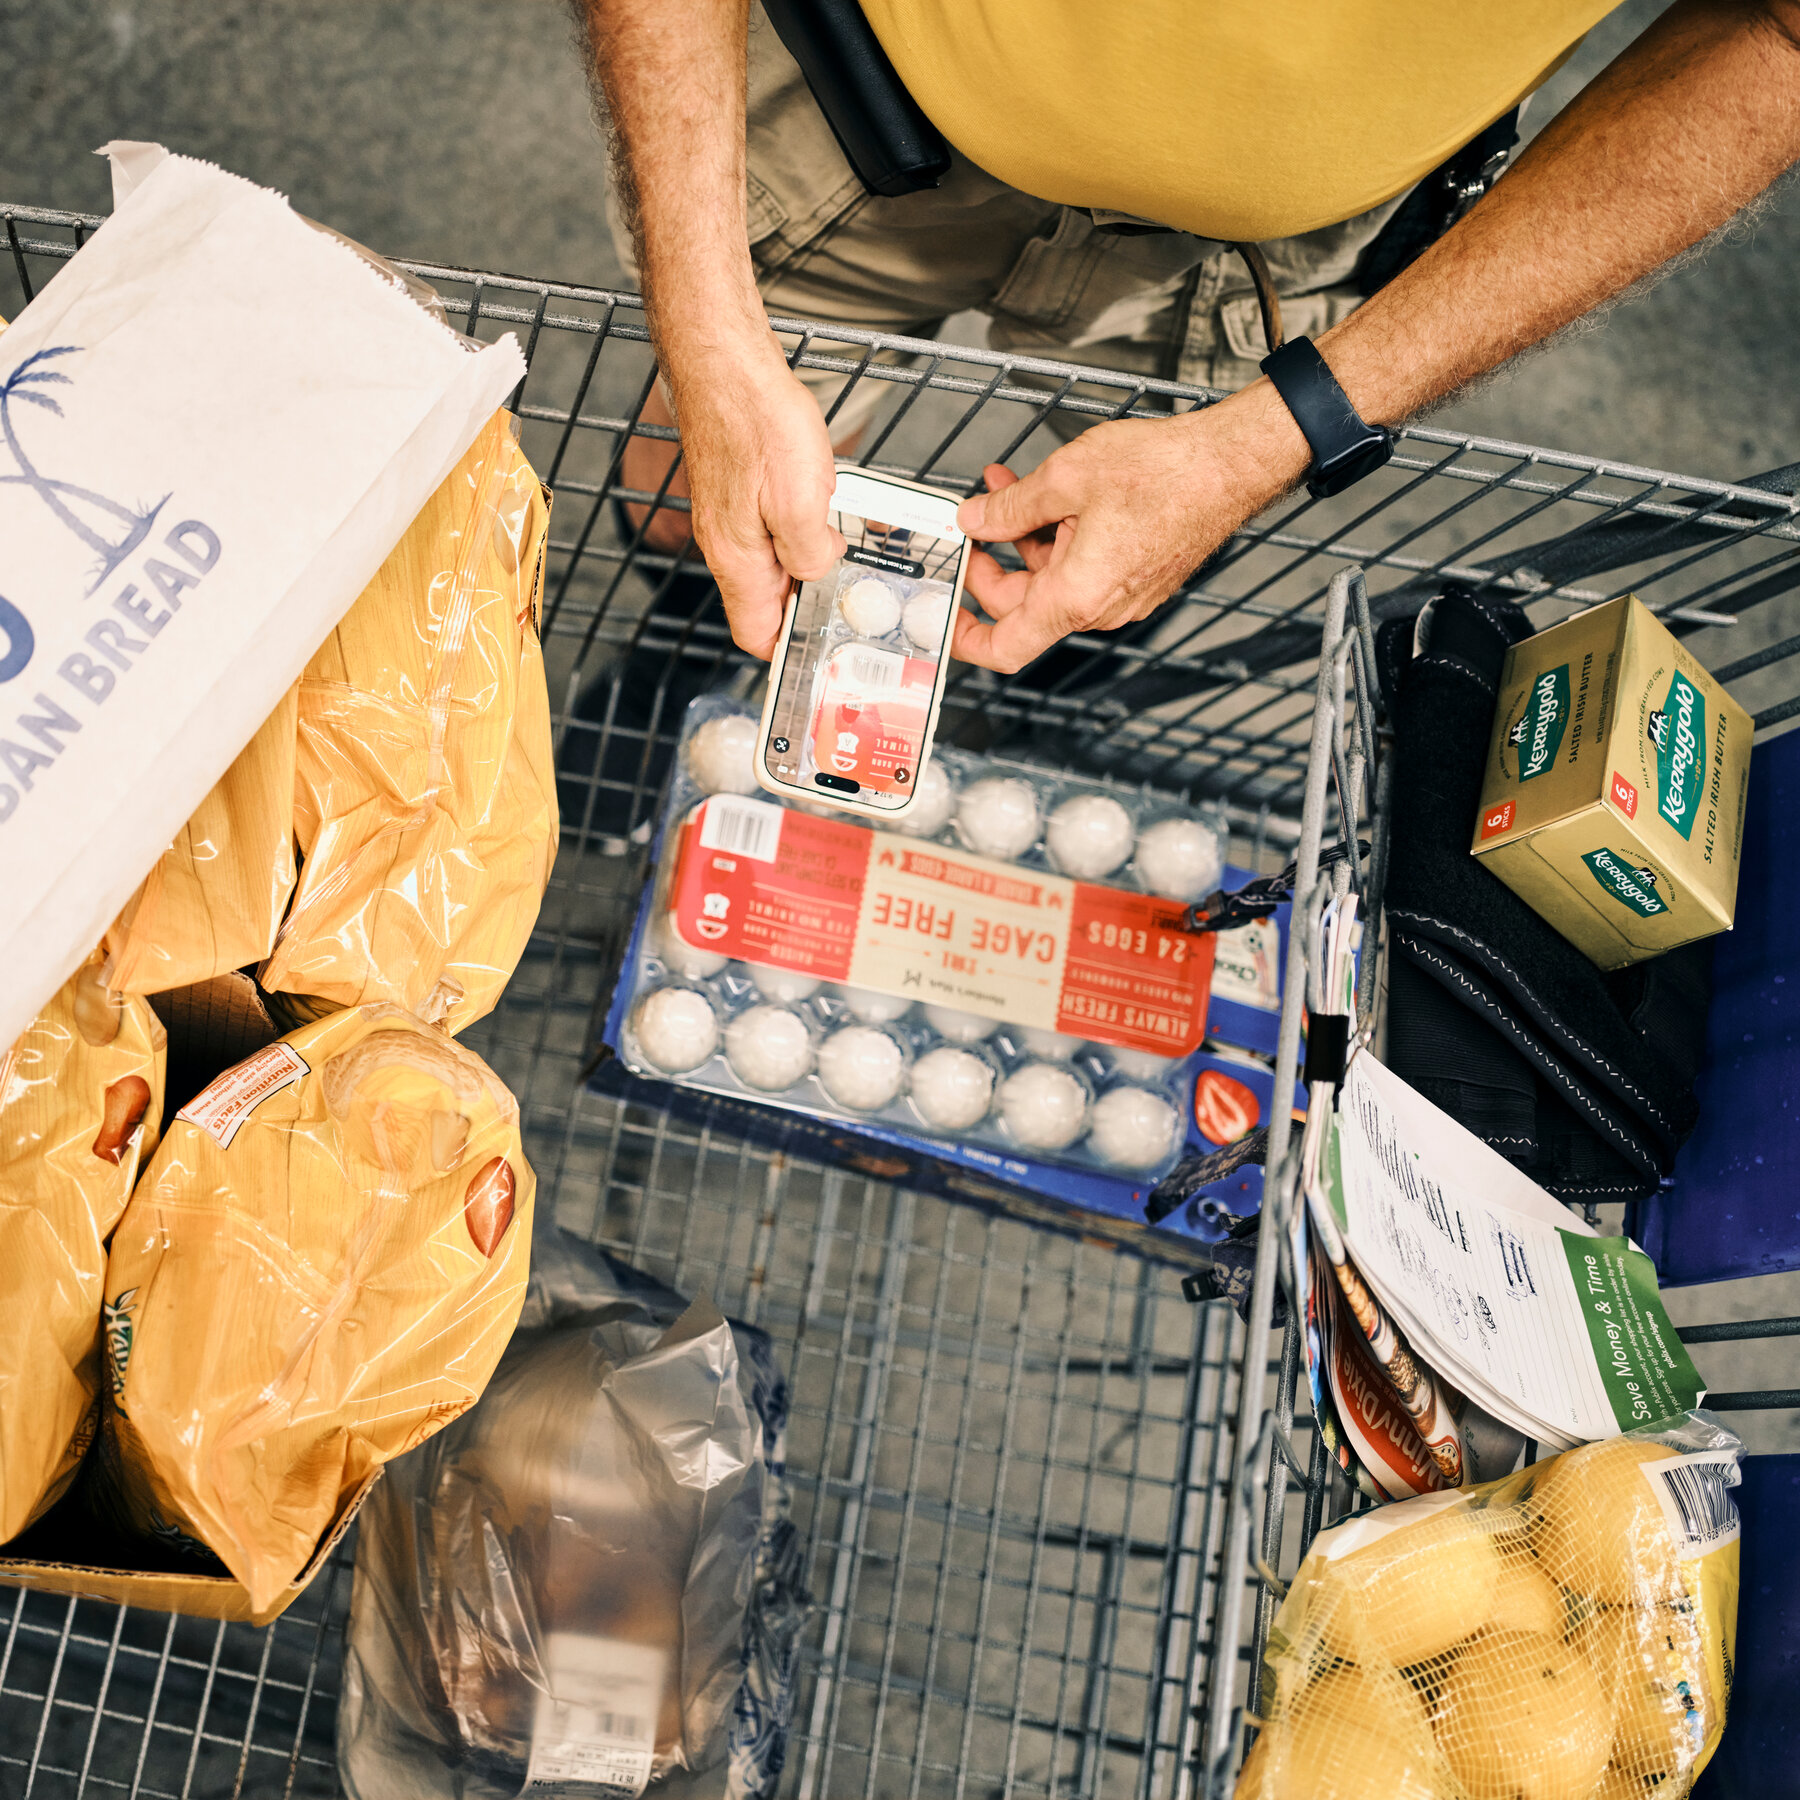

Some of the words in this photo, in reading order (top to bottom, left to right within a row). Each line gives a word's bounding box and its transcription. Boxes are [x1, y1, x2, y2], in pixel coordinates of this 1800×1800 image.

[887, 560, 899, 568] scan
[56, 519, 222, 706] BREAD
[1580, 652, 1594, 694] BUTTER
[1639, 679, 1654, 715] GRASS-FED
[1575, 695, 1587, 724] IRISH
[876, 738, 917, 754] ANIMAL
[1569, 725, 1582, 764] SALTED
[1714, 713, 1727, 767] BUTTER
[871, 758, 892, 769] BARN
[1643, 769, 1651, 789] MILK
[1709, 769, 1721, 808] IRISH
[1616, 783, 1628, 801] 6
[1626, 788, 1634, 813] STICKS
[1488, 814, 1502, 827] 6
[1501, 805, 1511, 828] STICKS
[1703, 809, 1717, 865] SALTED
[1634, 853, 1648, 863] FROM
[872, 893, 955, 940] FREE
[970, 917, 1057, 964] CAGE
[1088, 920, 1148, 954] EGGS
[1158, 936, 1187, 963] 24
[1061, 993, 1118, 1023] FRESH
[1123, 1006, 1190, 1039] ALWAYS
[242, 1070, 258, 1085] size
[242, 1063, 294, 1101] Nutrition
[211, 1079, 237, 1103] without
[213, 1101, 243, 1130] Facts
[1584, 1255, 1606, 1295] Time
[1607, 1267, 1615, 1277] by
[1616, 1256, 1627, 1277] today.
[1610, 1278, 1620, 1295] order
[1621, 1277, 1632, 1297] online
[1594, 1300, 1612, 1315] &
[1613, 1295, 1621, 1303] in
[1628, 1297, 1641, 1322] account
[1618, 1308, 1628, 1320] list
[1623, 1318, 1638, 1347] shopping
[1636, 1322, 1645, 1335] free
[1645, 1310, 1678, 1370] publix.com/signup
[1604, 1318, 1635, 1378] Money
[1635, 1346, 1646, 1361] your
[1641, 1334, 1652, 1349] your
[1645, 1348, 1655, 1359] for
[1651, 1357, 1661, 1366] up
[1654, 1365, 1666, 1380] Sign
[1641, 1363, 1655, 1388] account,
[1626, 1382, 1652, 1420] Save
[1653, 1387, 1663, 1406] Publix
[1668, 1393, 1680, 1407] your
